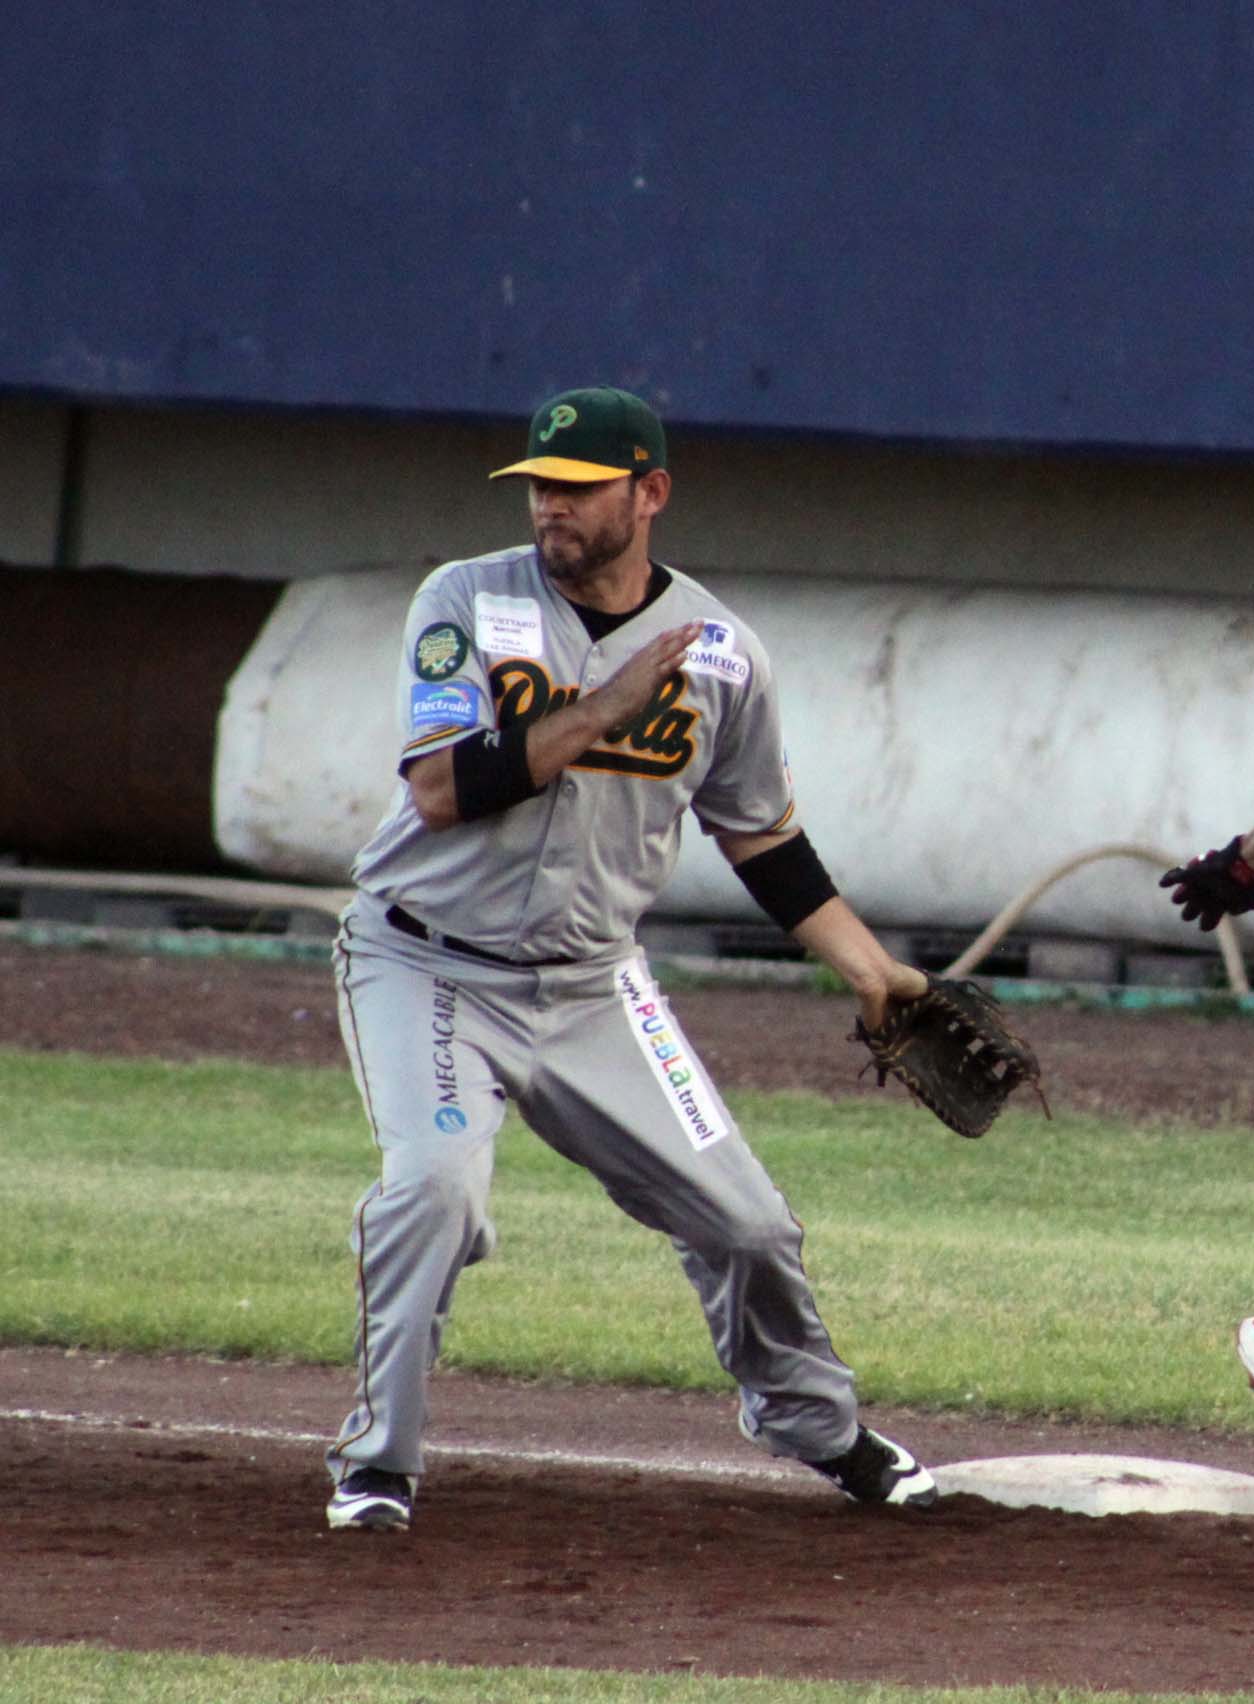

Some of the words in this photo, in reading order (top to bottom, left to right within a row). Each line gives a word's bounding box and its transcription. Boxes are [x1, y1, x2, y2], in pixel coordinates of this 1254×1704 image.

[539, 404, 578, 442] P
[413, 699, 472, 714] Electrolit
[432, 976, 460, 1106] MEGACABLE
